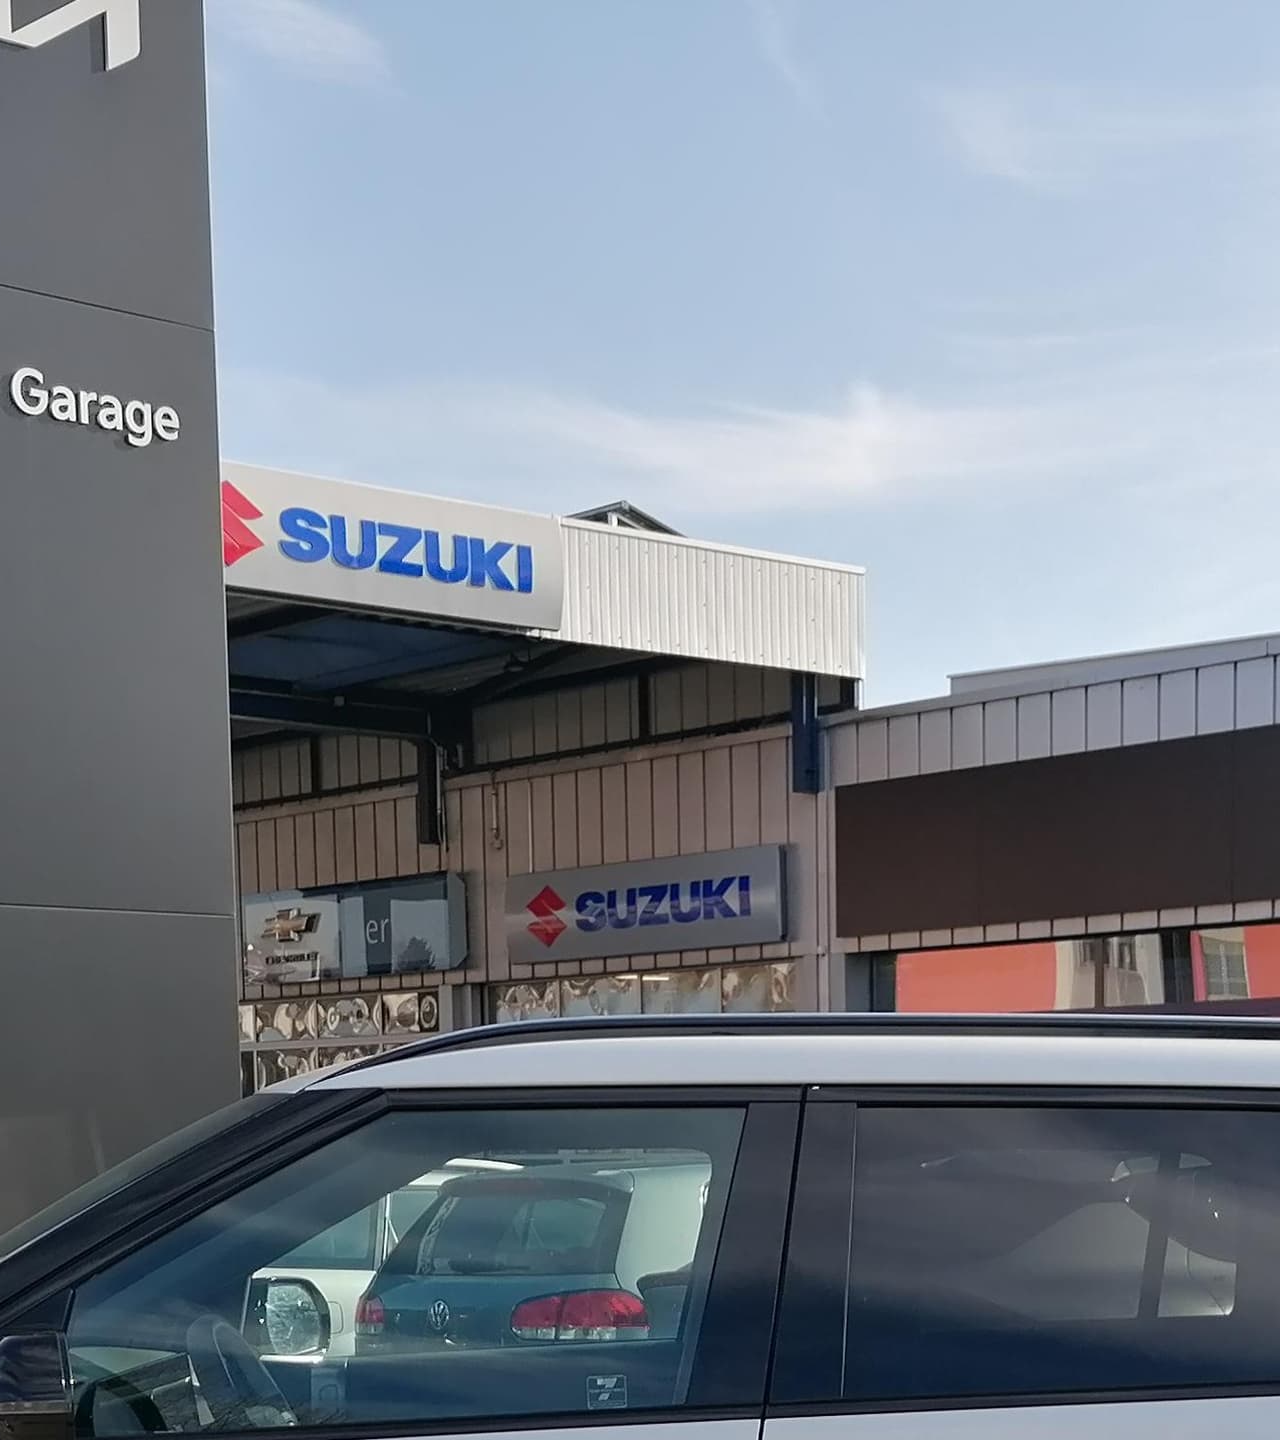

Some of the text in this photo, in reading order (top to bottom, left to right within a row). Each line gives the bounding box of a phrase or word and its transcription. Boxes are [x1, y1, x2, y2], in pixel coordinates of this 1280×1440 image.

[10, 366, 181, 448] Garage
[278, 506, 534, 595] SUZUKI
[575, 875, 752, 932] SUZUKI
